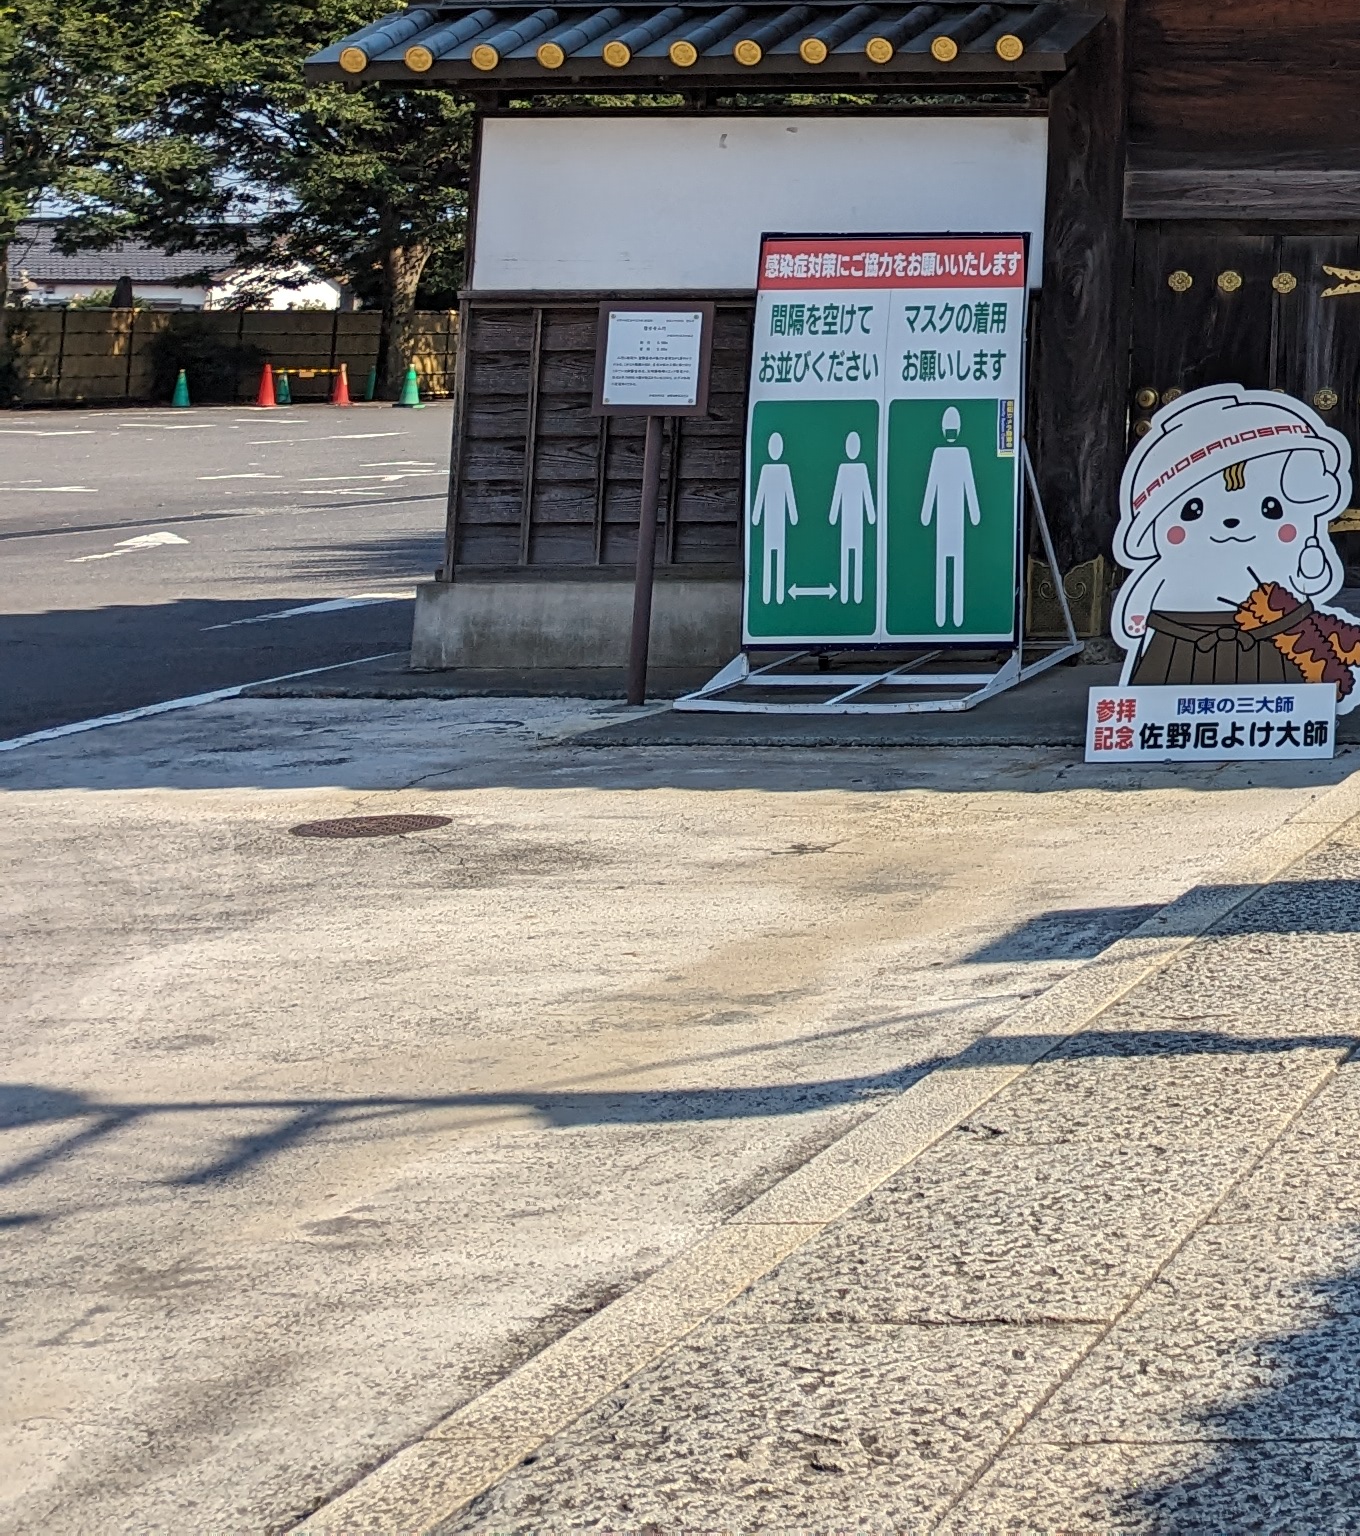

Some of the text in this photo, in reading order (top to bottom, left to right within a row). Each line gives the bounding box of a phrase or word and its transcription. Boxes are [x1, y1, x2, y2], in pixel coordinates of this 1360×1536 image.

[765, 252, 1022, 279] 感染症対策にご協力をお願いいたします
[770, 303, 874, 336] 間隔を空けて
[904, 302, 1008, 335] マスクの着用
[758, 350, 879, 383] お並びください
[901, 349, 1007, 381] お願いします
[1096, 699, 1137, 723] 参拝
[1176, 696, 1295, 715] 関東の三大師
[1094, 725, 1135, 751] 記念
[1138, 719, 1329, 750] 佐野厄よけ大師
